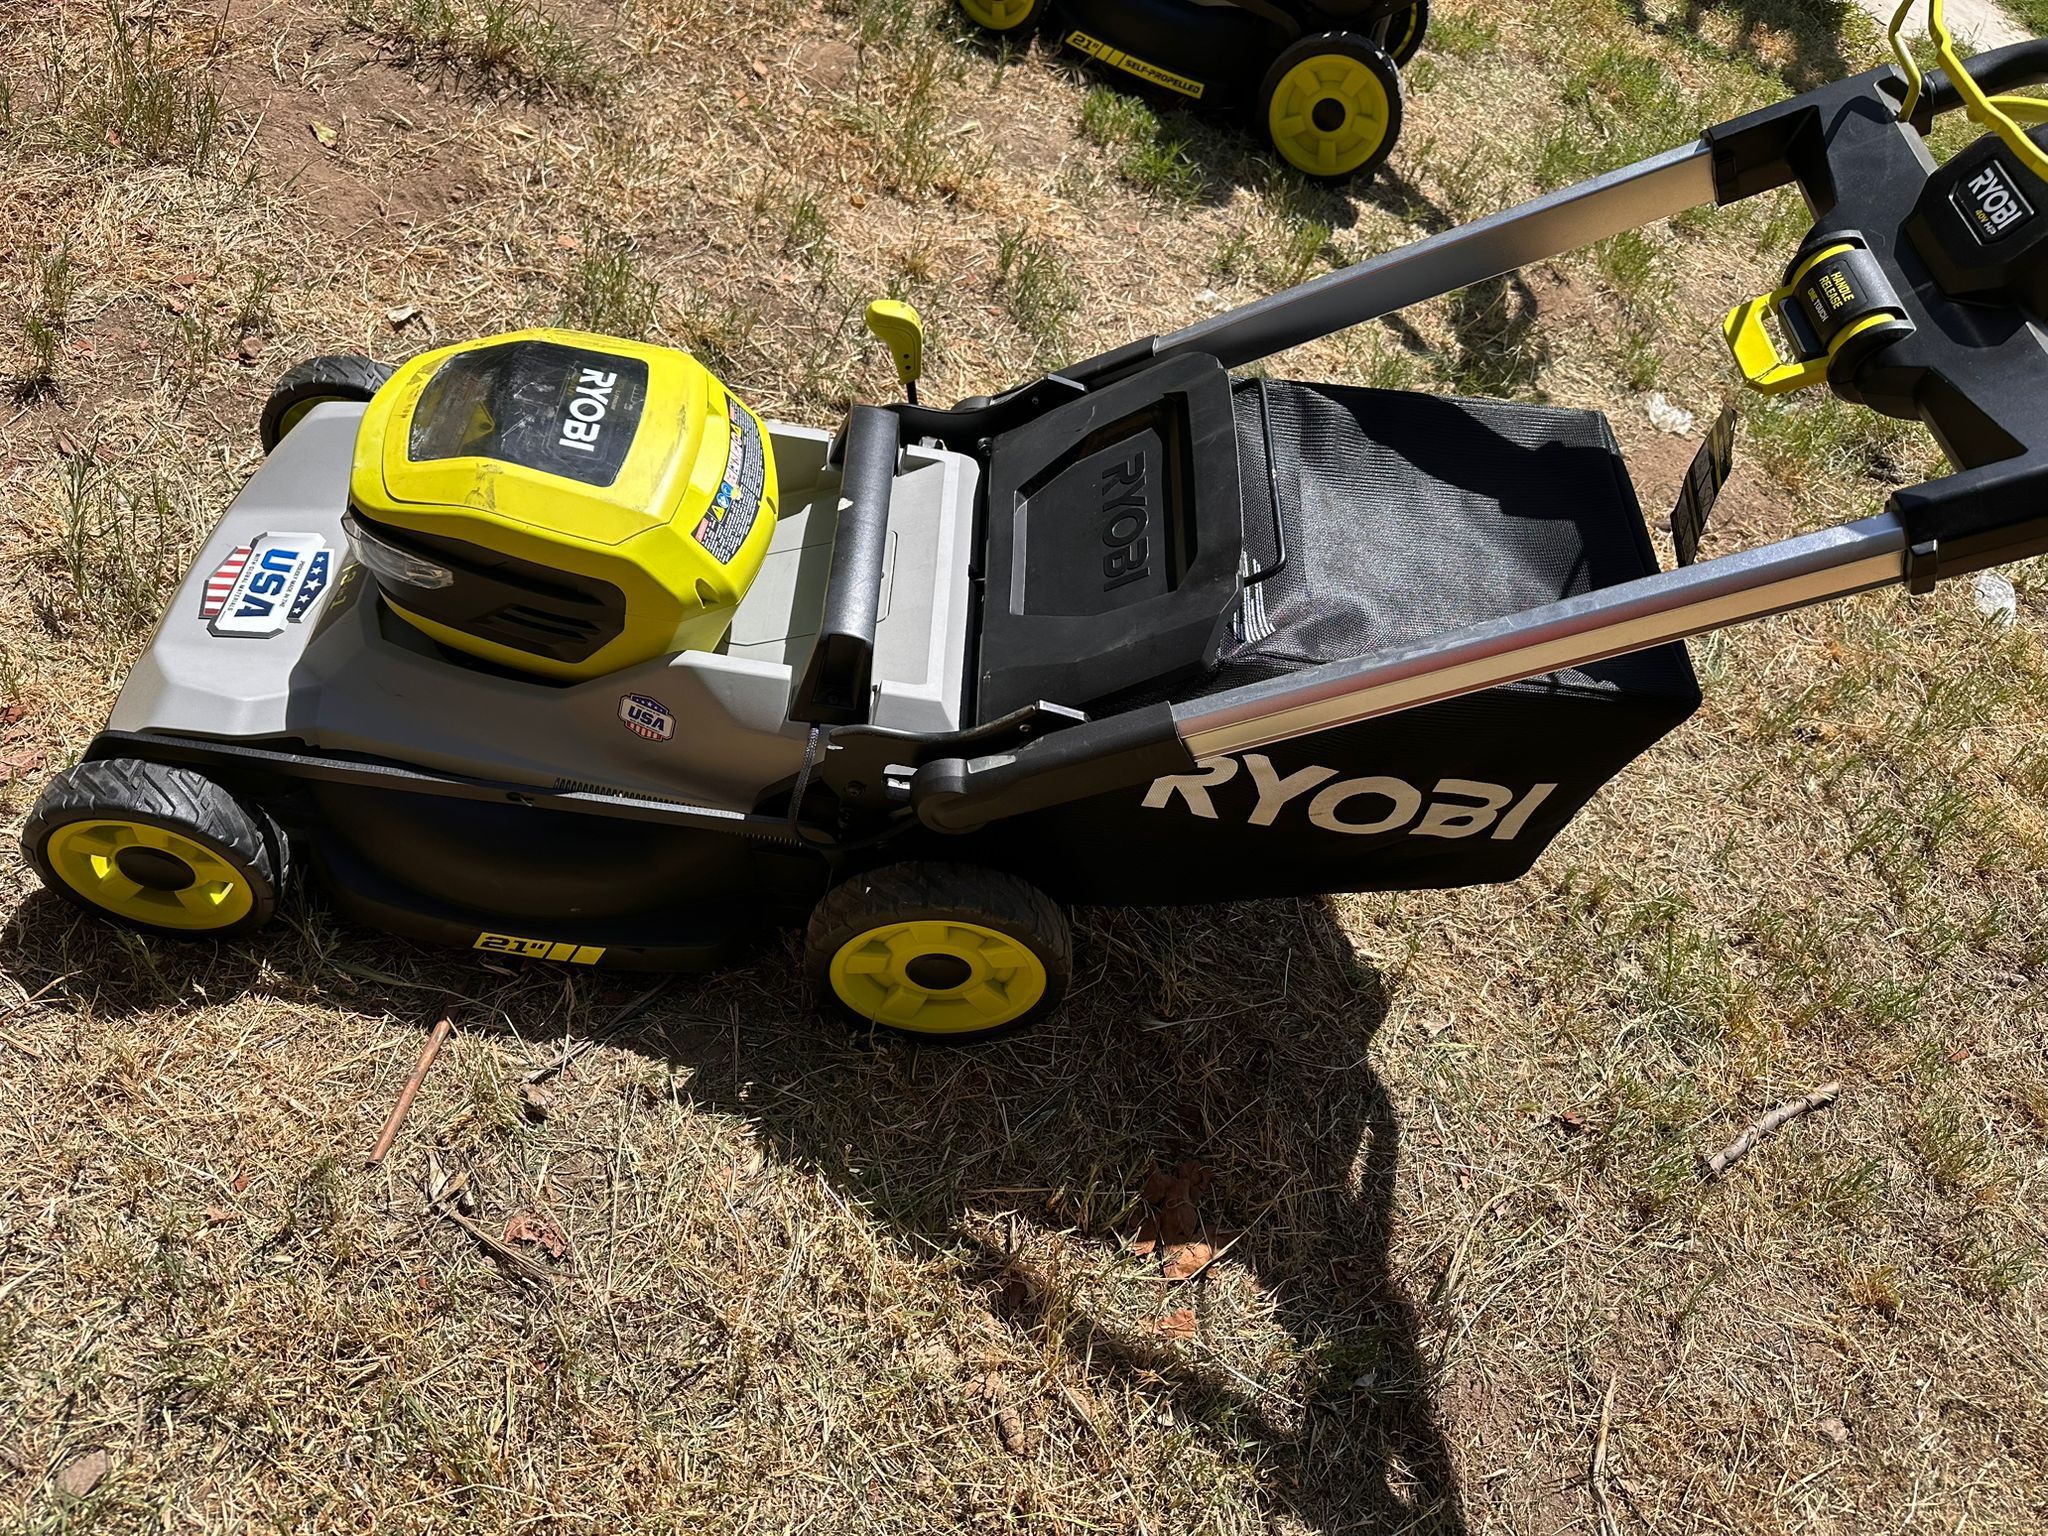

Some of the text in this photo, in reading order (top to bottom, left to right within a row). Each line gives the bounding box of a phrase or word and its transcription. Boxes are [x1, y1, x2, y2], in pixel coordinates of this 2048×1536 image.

[1072, 34, 1200, 94] 21" SELF-PROPELLED
[1967, 167, 2022, 230] RYOBI
[1983, 221, 1997, 235] HP
[1819, 275, 1843, 310] RELEASE
[1830, 271, 1855, 302] HANDLE
[1807, 287, 1829, 322] ONE TOUCH
[558, 367, 618, 452] RYOBI
[1102, 450, 1151, 593] RYOBI
[227, 584, 245, 611] MATERIALS
[234, 548, 299, 617] USA
[286, 580, 297, 592] MADE
[628, 705, 665, 732] USA
[1141, 754, 1559, 840] RYOBI
[480, 936, 545, 954] 21"
